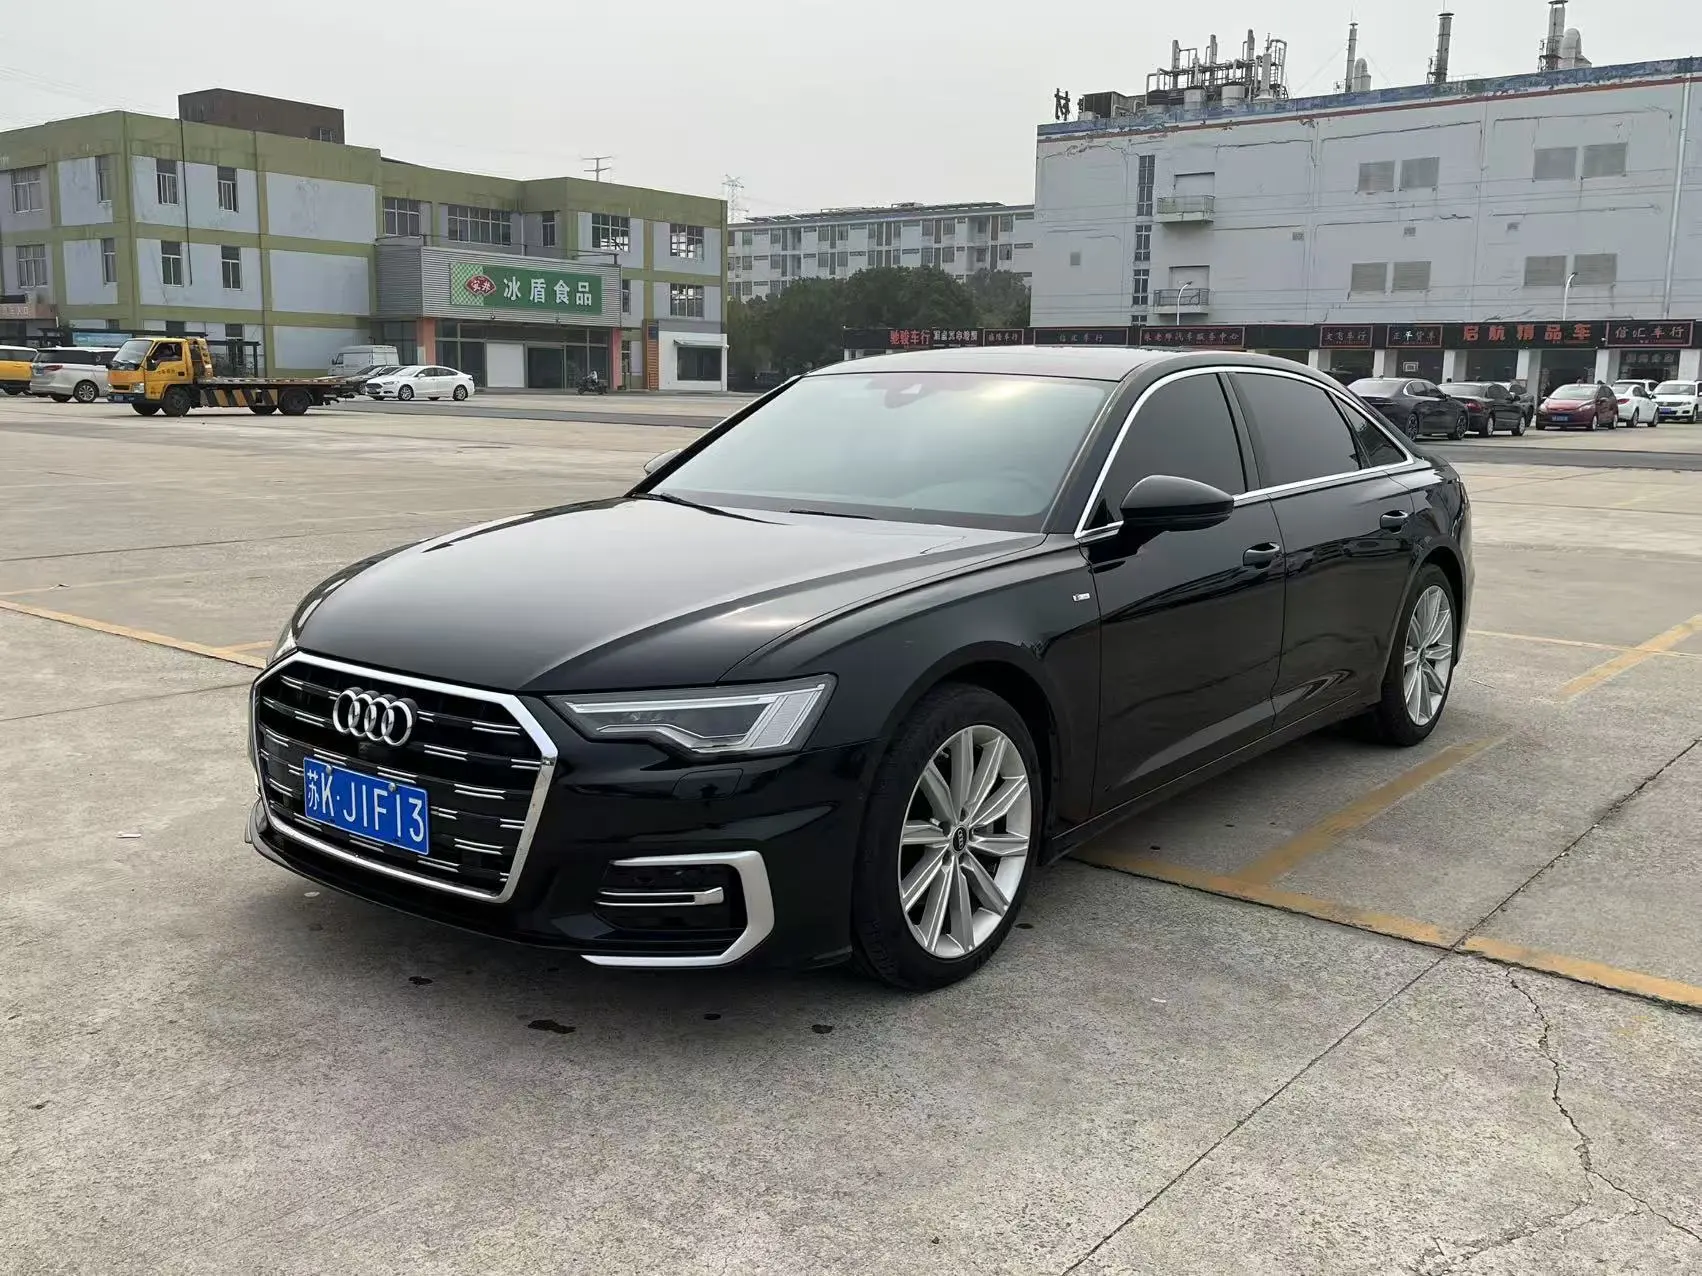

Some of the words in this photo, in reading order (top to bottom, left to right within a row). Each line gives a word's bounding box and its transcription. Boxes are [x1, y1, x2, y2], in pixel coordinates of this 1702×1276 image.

[503, 276, 592, 306] 冰盾食品
[1463, 323, 1591, 341] 启航精品车
